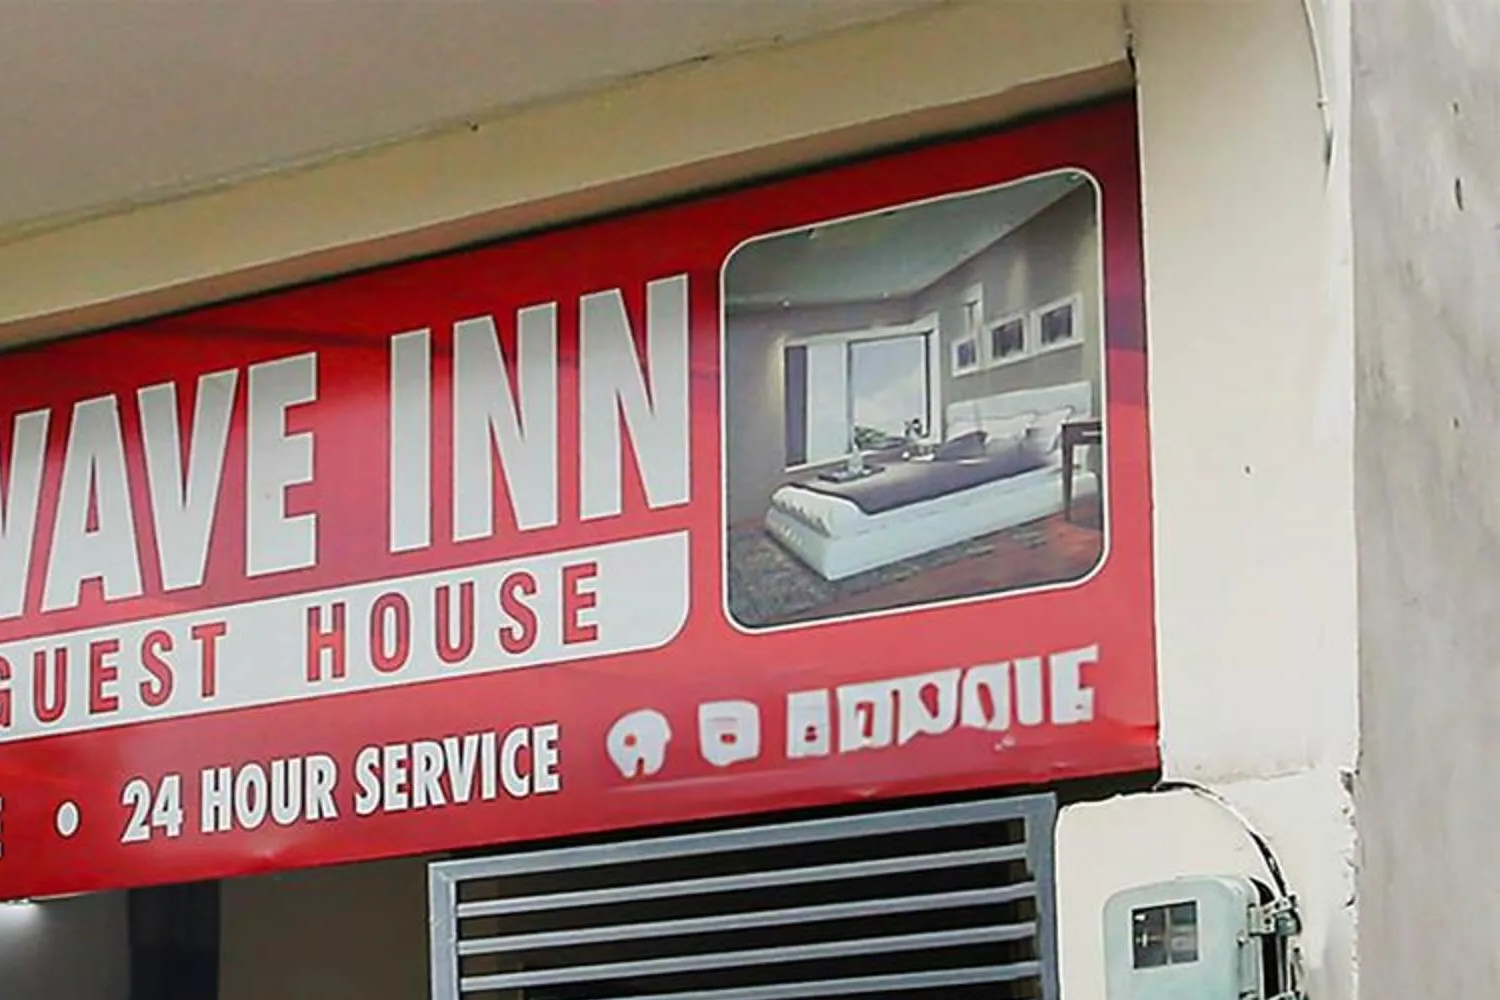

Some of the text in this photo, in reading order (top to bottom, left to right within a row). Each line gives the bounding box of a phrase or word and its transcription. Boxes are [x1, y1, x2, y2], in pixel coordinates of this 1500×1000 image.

[390, 273, 690, 554] INN
[306, 562, 600, 684] HOUSE
[120, 774, 184, 844] 24
[200, 754, 339, 834] HOUR
[354, 722, 561, 816] SERVICE
